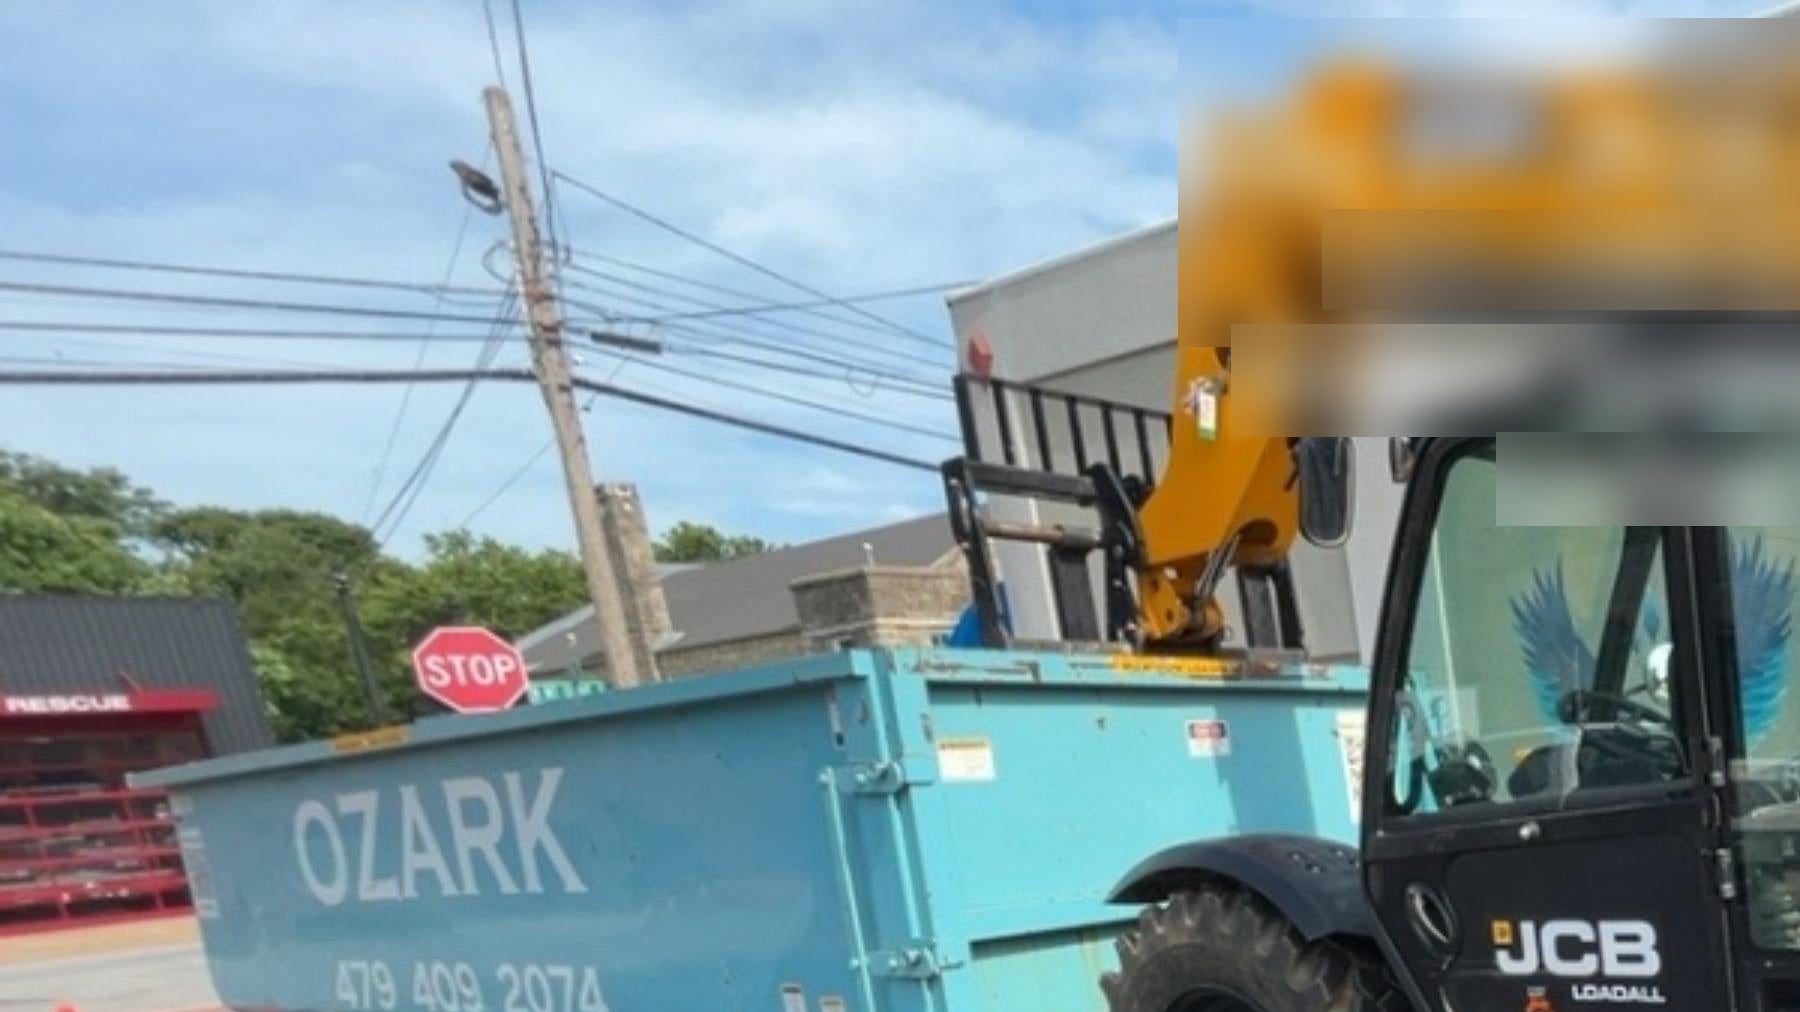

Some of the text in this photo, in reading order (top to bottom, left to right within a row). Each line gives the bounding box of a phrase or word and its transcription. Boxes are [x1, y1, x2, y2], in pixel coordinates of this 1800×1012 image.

[424, 653, 516, 687] STOP
[6, 695, 133, 712] RESCUE
[293, 767, 588, 906] OZARK
[1495, 919, 1662, 977] JCB
[335, 959, 397, 1011] 479
[1571, 984, 1666, 1003] LOADALL
